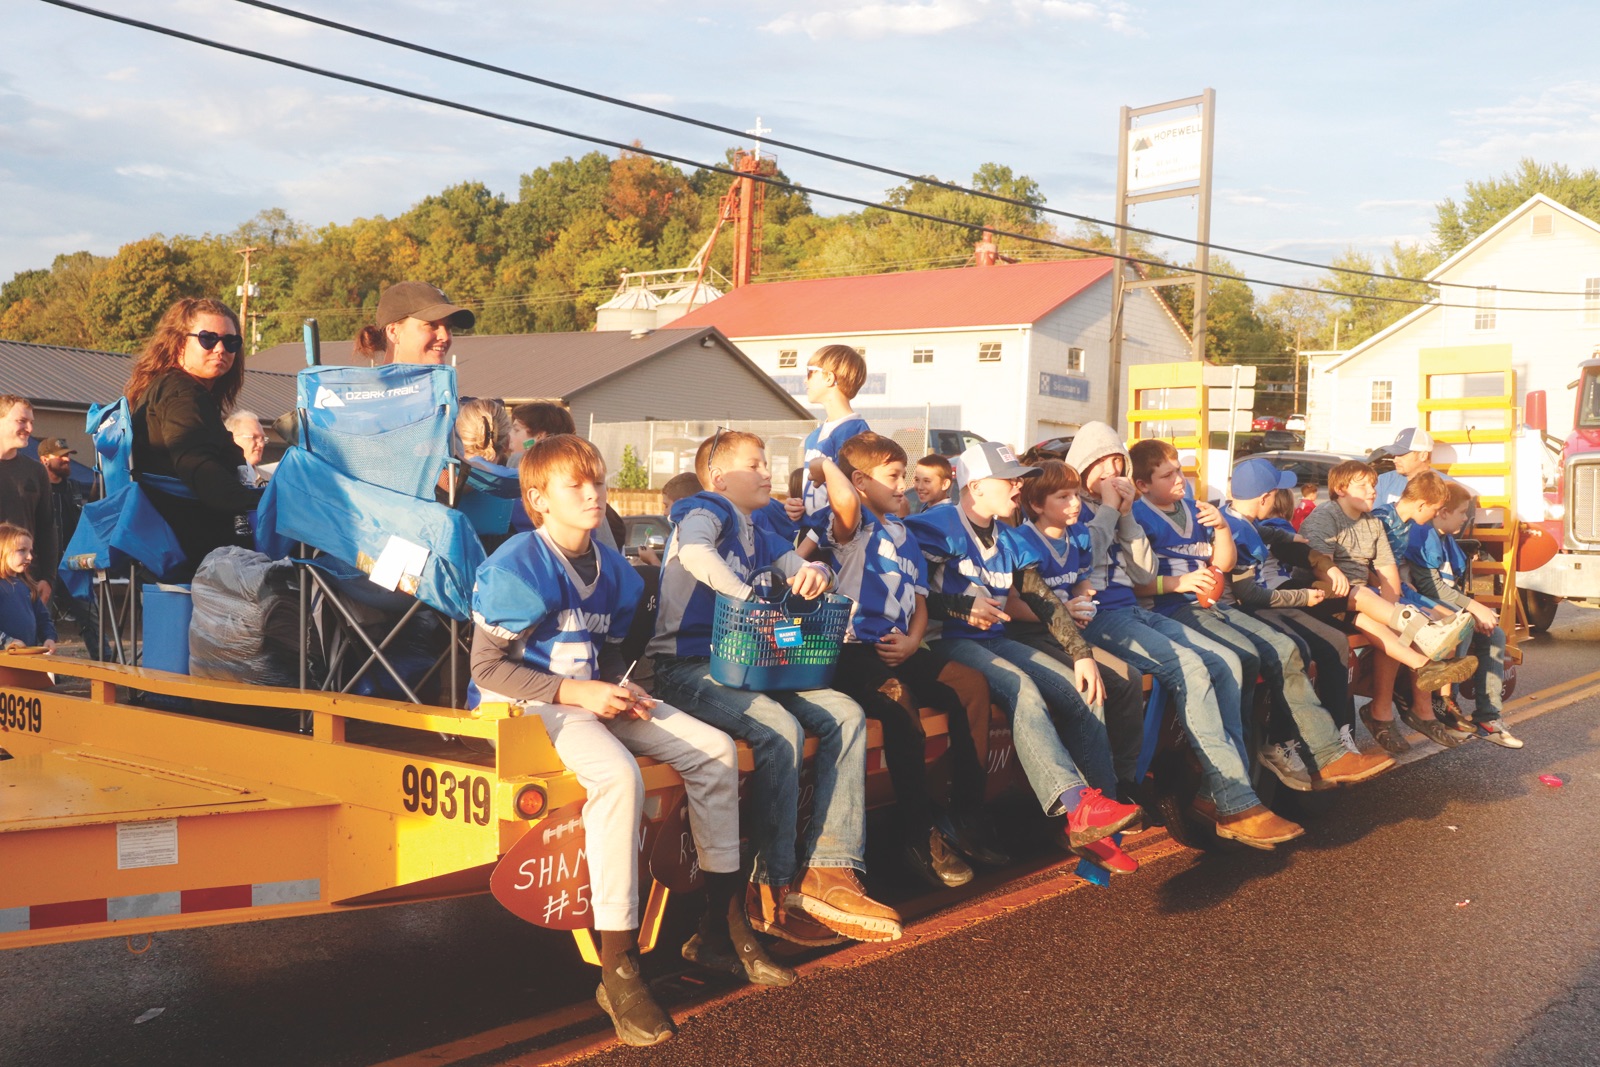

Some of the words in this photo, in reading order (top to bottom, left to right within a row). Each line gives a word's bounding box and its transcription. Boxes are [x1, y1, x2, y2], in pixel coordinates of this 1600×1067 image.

[1154, 123, 1203, 140] HOPEWELL
[0, 692, 42, 733] 99319
[402, 764, 491, 827] 99319
